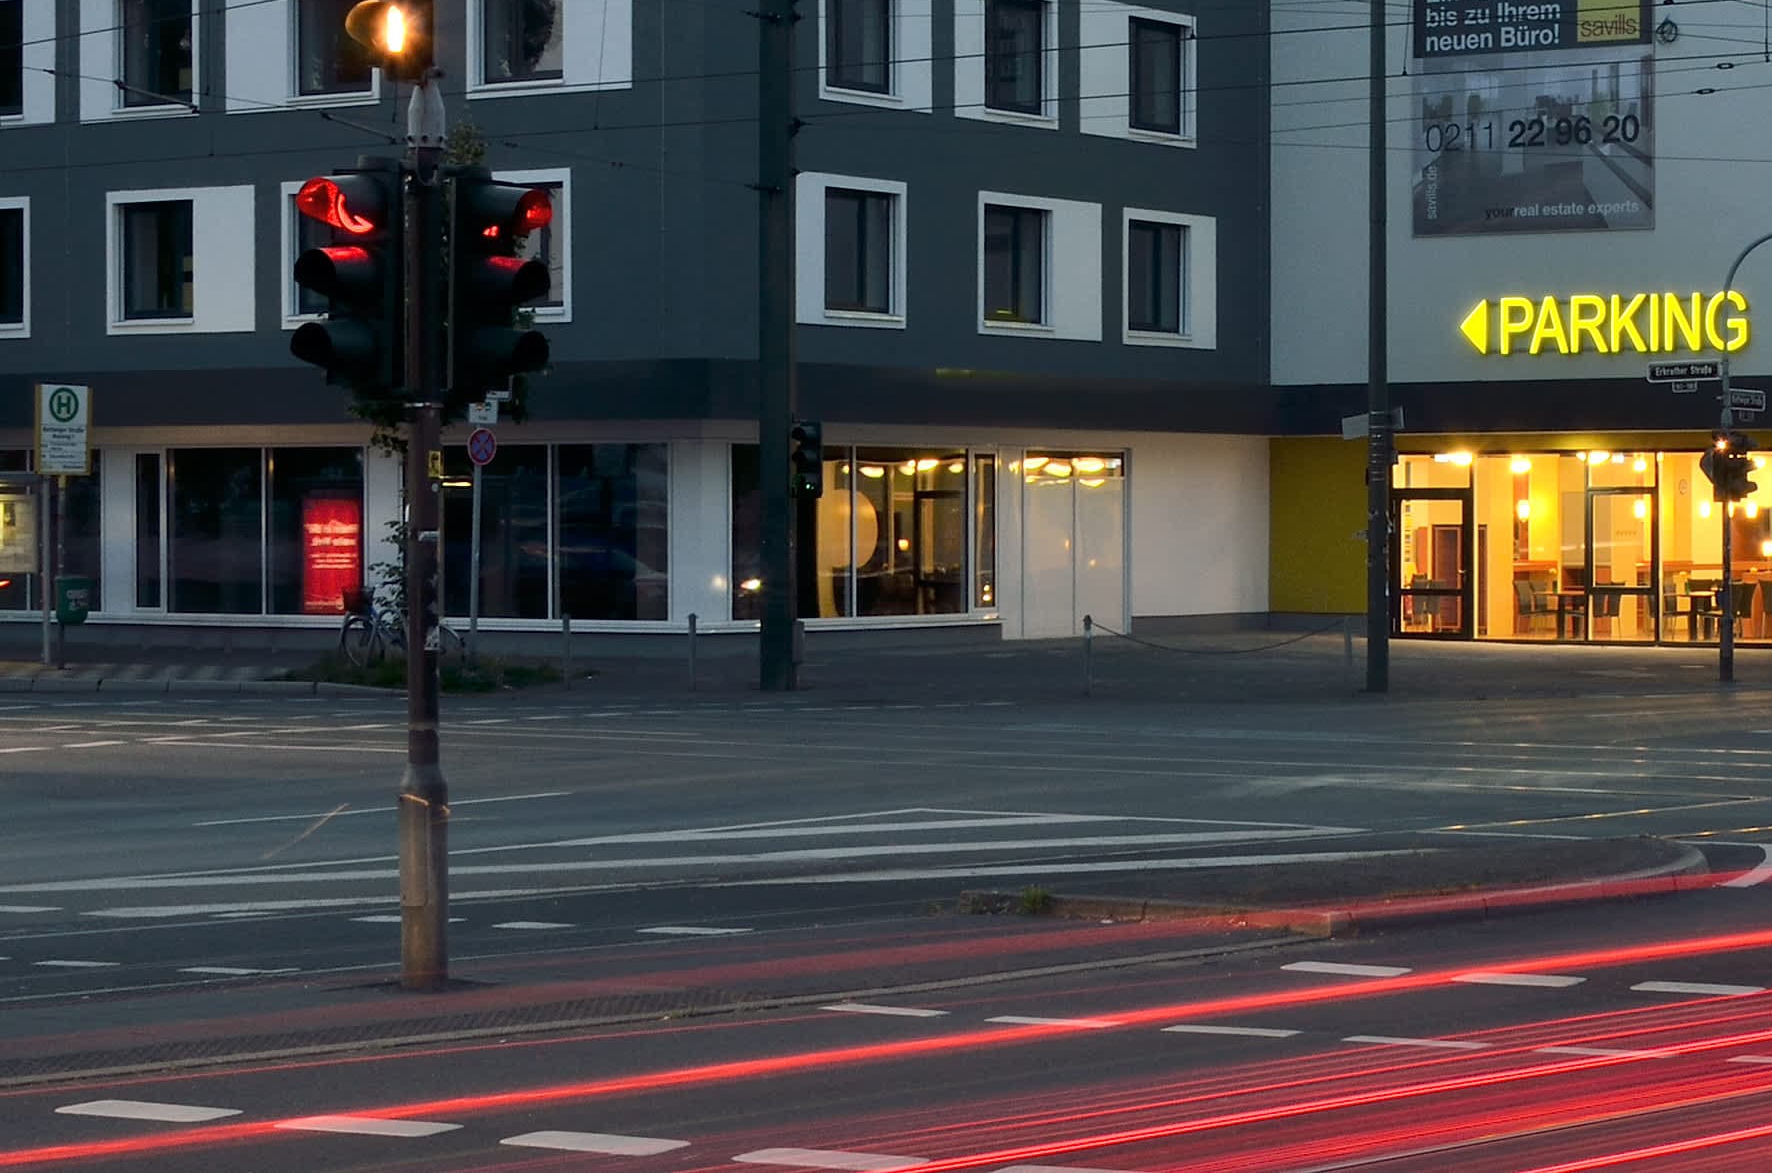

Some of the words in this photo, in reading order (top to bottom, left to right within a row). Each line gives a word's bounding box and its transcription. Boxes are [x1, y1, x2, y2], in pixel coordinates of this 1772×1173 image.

[1426, 6, 1458, 27] bis
[1464, 8, 1490, 25] zu
[1497, 2, 1561, 23] Ihrem
[1581, 14, 1637, 37] savills
[1426, 32, 1493, 52] neuen
[1500, 24, 1559, 47] Büro!
[1426, 122, 1493, 152] 0211
[1508, 118, 1545, 148] 22
[1555, 115, 1592, 146] 96
[1603, 114, 1640, 144] 20
[1542, 201, 1584, 216] estate
[1588, 200, 1640, 217] experts
[1500, 291, 1750, 355] PARKING
[57, 395, 71, 414] H
